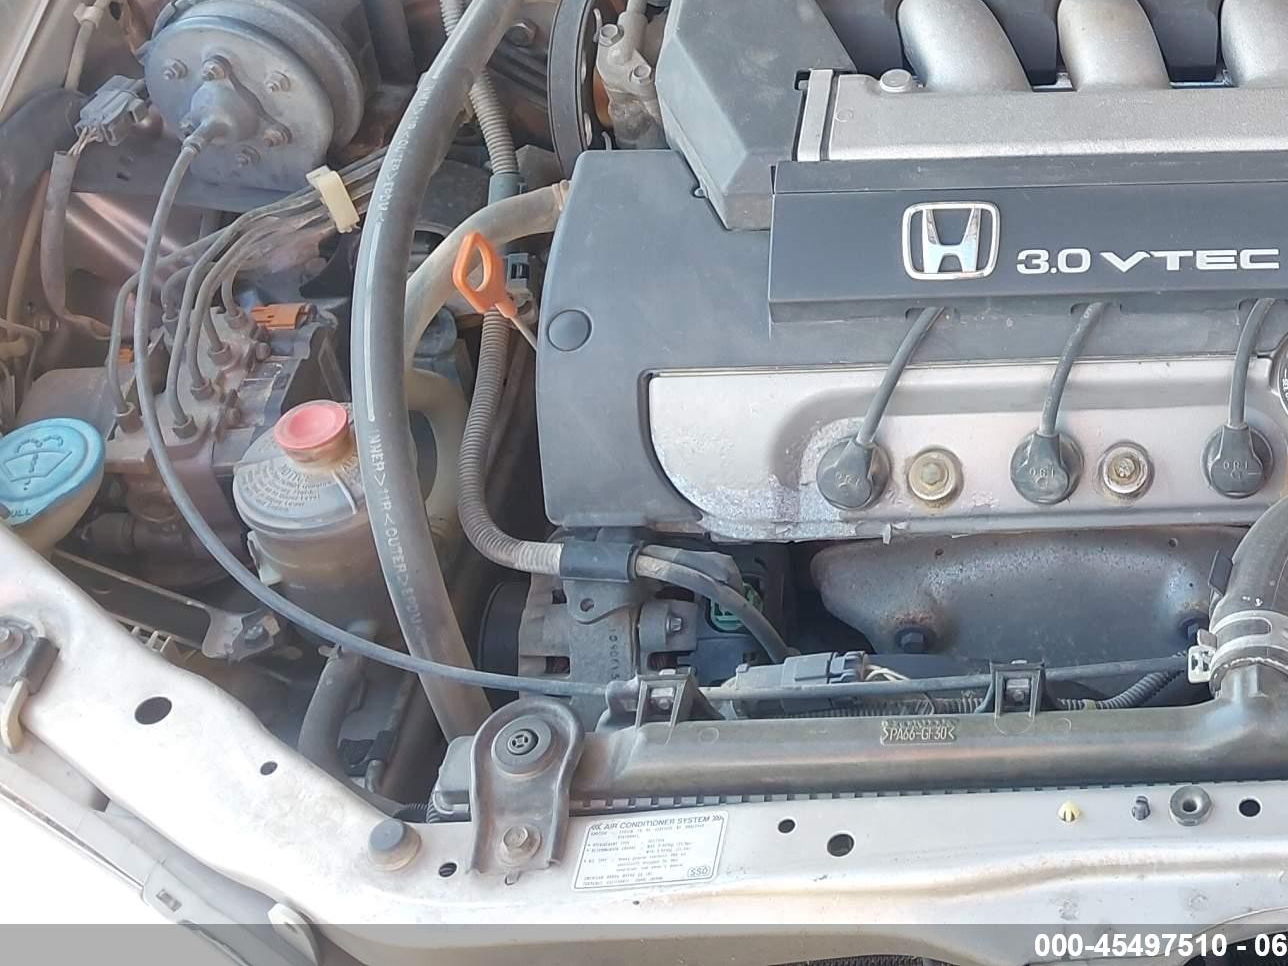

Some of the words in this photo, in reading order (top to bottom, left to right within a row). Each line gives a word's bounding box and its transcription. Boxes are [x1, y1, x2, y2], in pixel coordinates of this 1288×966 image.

[1015, 247, 1092, 275] 3.0
[1099, 247, 1280, 274] VTEC
[620, 818, 675, 829] CONDITIONER
[677, 815, 711, 825] SYSTEM
